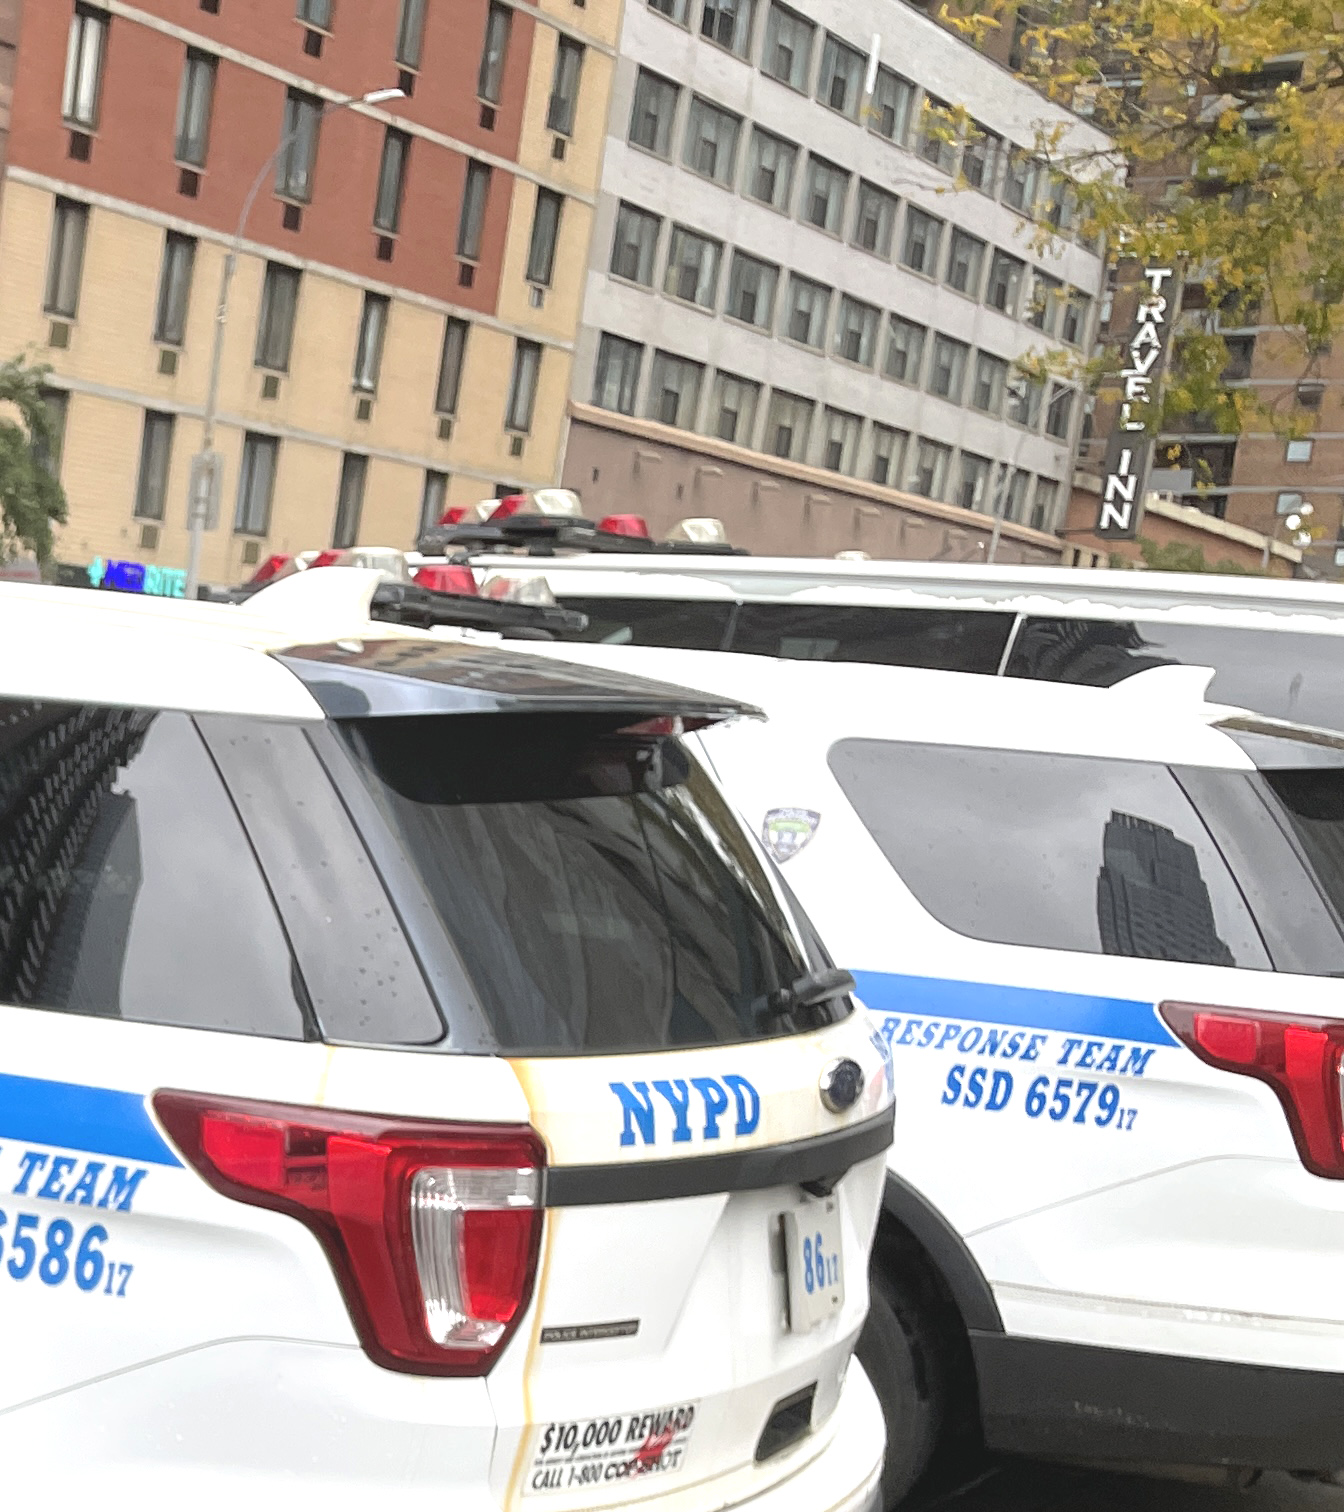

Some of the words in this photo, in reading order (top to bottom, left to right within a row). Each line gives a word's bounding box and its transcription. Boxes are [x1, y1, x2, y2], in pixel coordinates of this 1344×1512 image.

[1119, 267, 1173, 432] TRAVEL
[1099, 449, 1138, 530] INN
[880, 1016, 1048, 1062] RESPONSE
[1057, 1038, 1157, 1077] TEAM
[608, 1074, 761, 1146] NYPD
[940, 1063, 1014, 1112] SSD
[1024, 1074, 1121, 1128] 6579
[11, 1150, 150, 1214] TEAM
[540, 1418, 623, 1458] $10,000
[624, 1403, 695, 1444] REWARD
[531, 1465, 564, 1491] CALL
